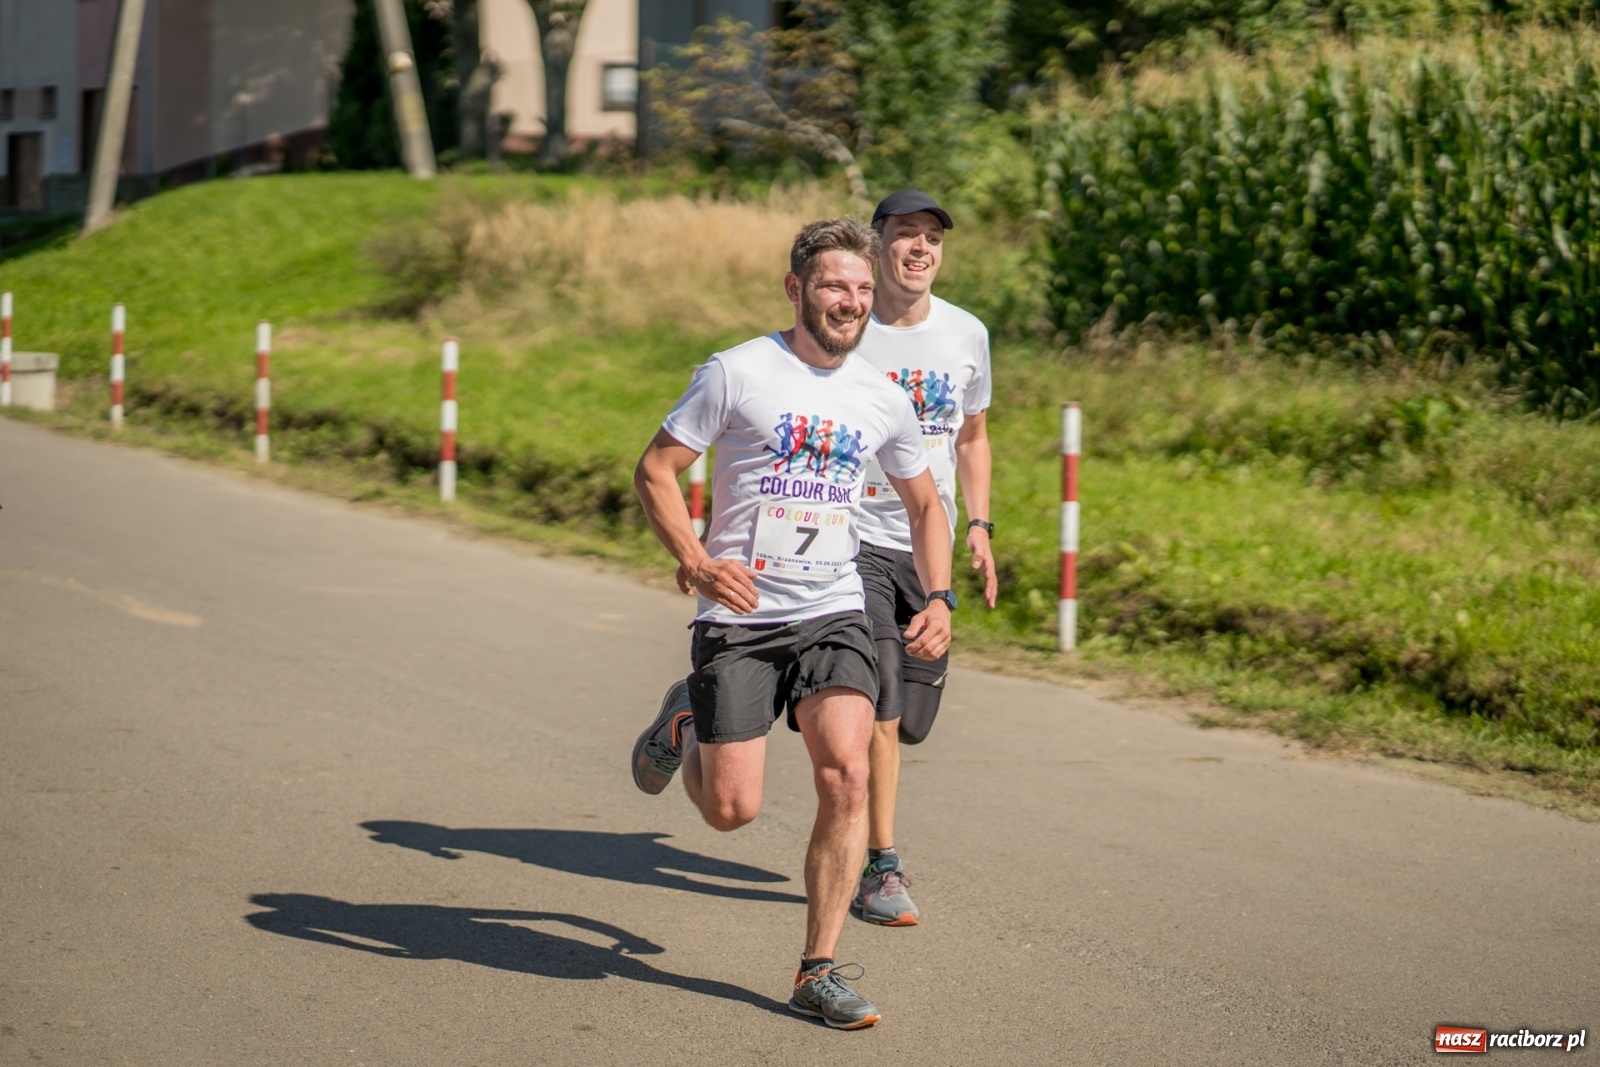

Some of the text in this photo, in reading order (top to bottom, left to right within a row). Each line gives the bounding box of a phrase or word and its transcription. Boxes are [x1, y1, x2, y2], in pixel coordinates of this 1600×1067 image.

[925, 438, 943, 450] RUN
[760, 476, 852, 503] COLOUR RUN
[767, 507, 845, 526] COLOUR RUN
[794, 526, 819, 555] 7
[756, 552, 774, 560] 10km,
